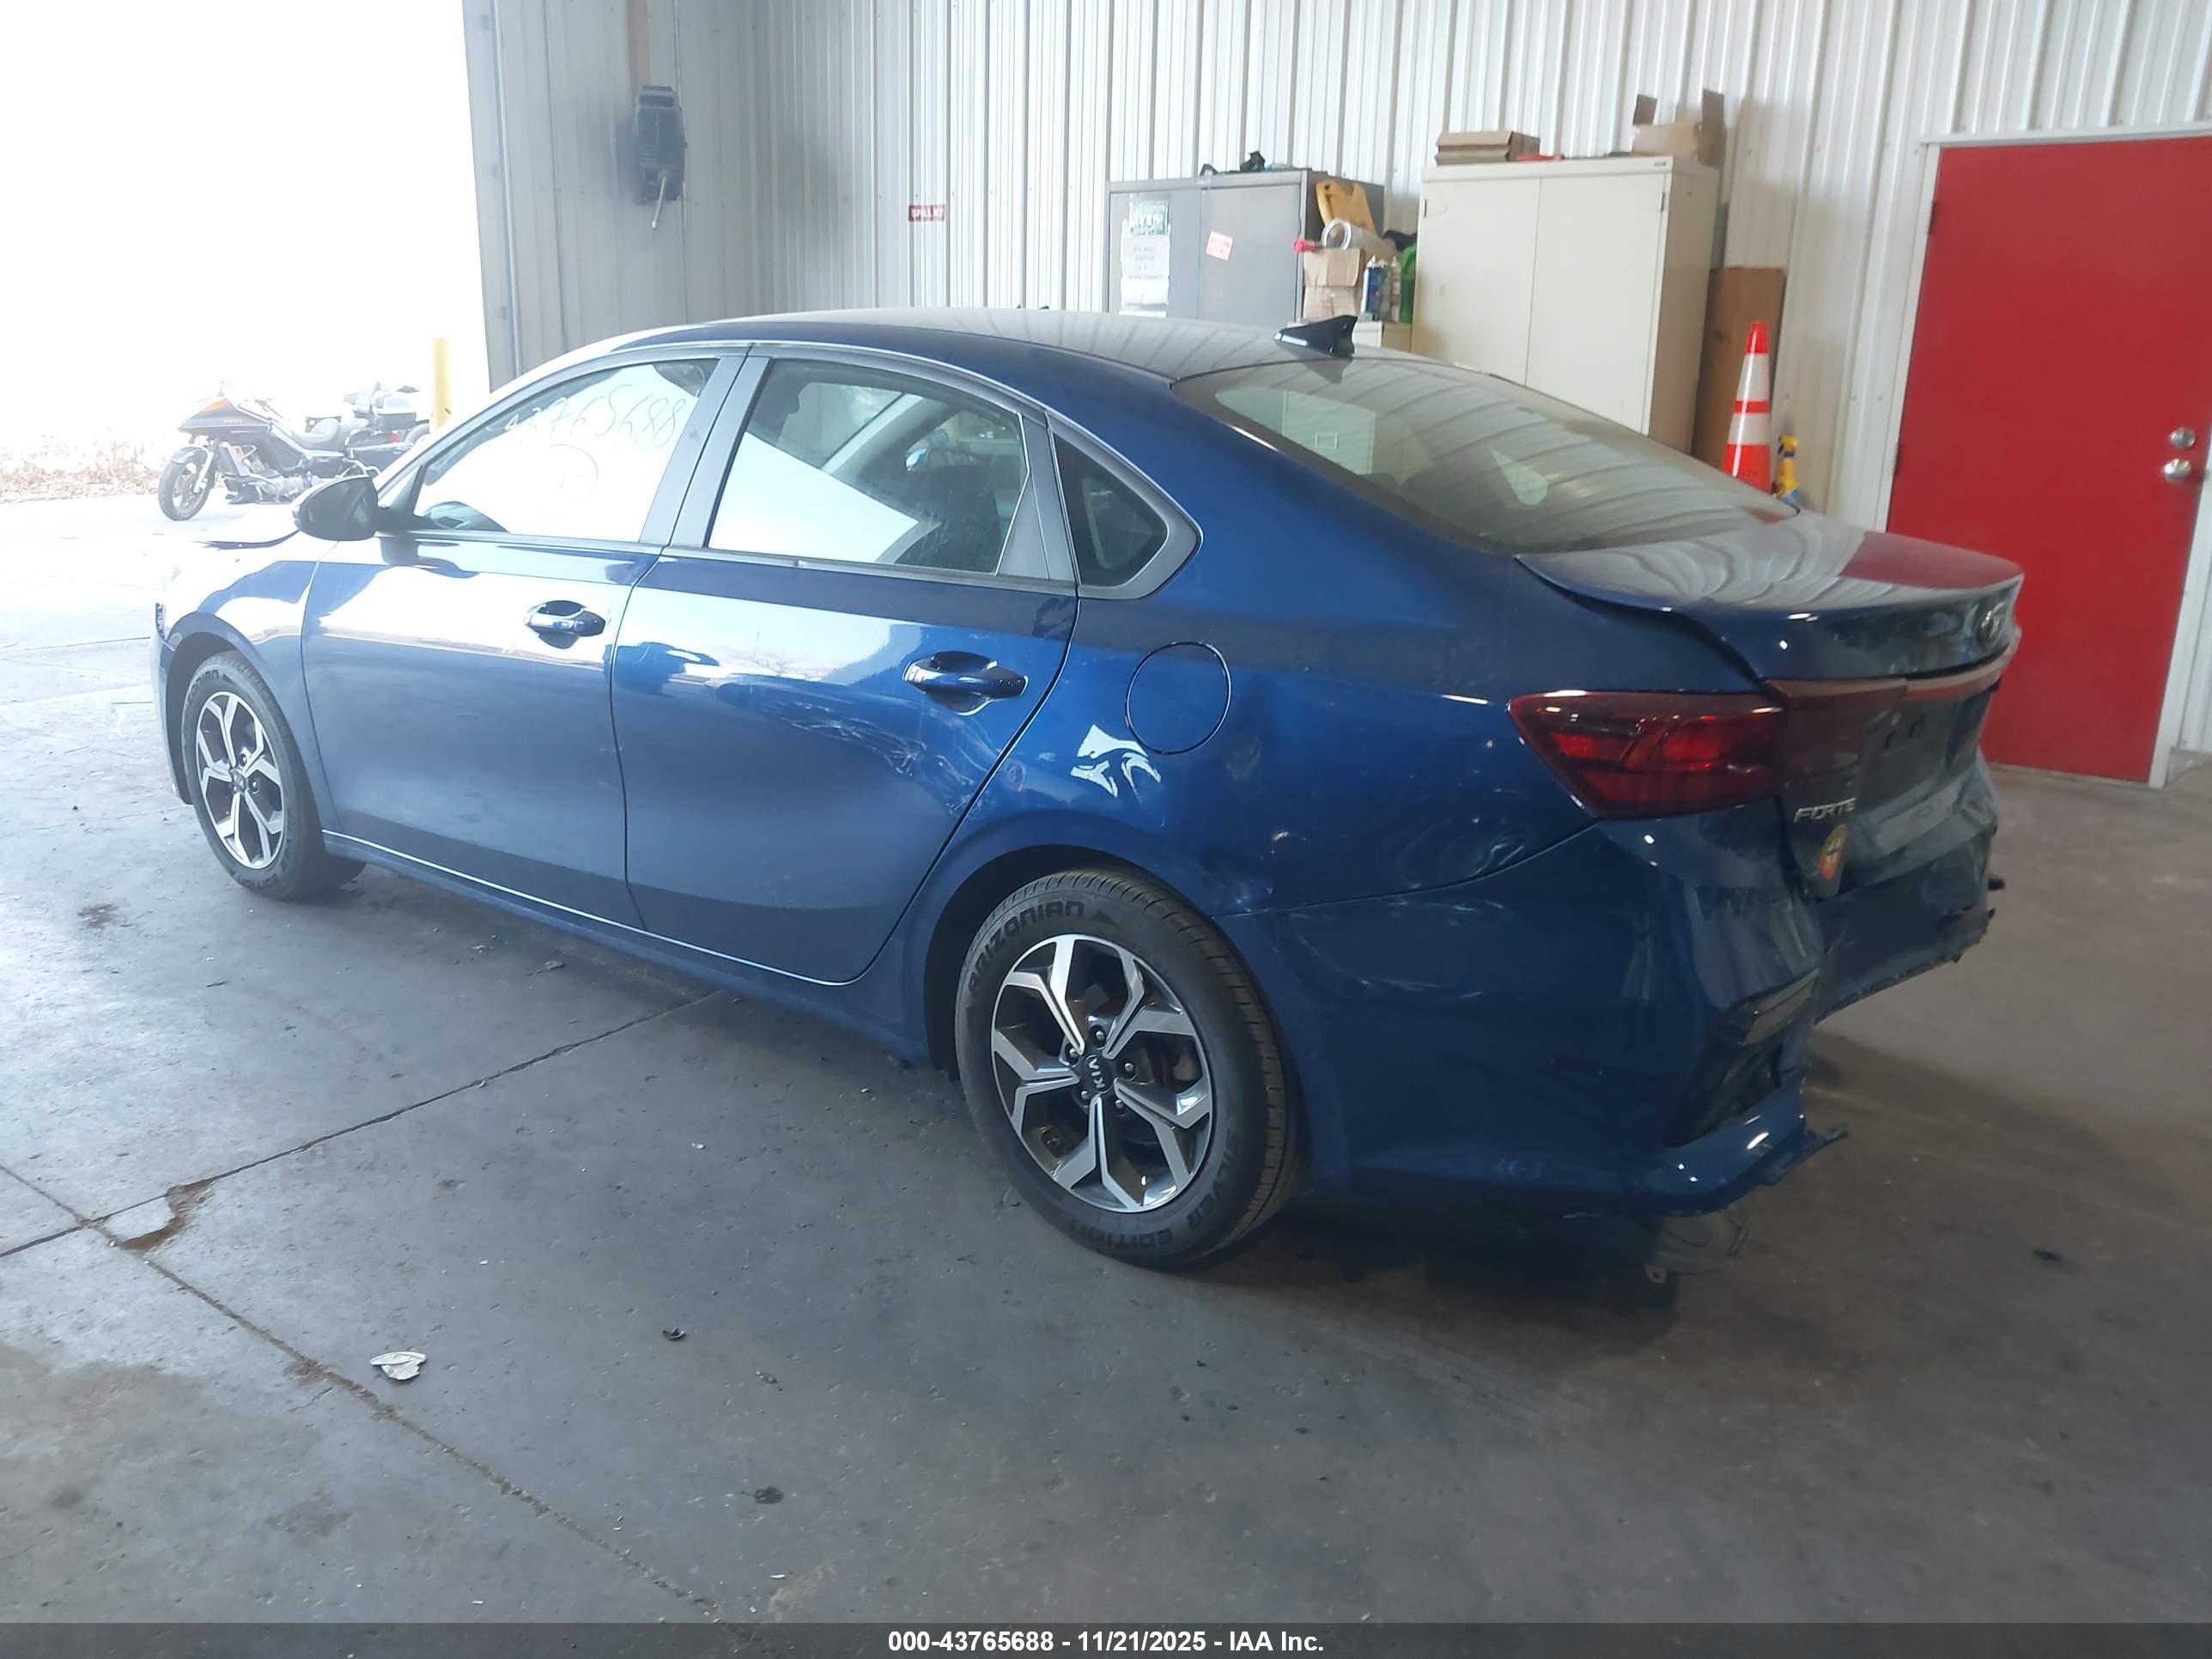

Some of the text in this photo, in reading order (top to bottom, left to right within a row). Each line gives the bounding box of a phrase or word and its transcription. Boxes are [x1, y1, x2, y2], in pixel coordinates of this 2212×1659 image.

[1793, 796, 1856, 823] FORTE
[968, 901, 1085, 991] ARIZONIAN
[1088, 1057, 1106, 1089] KIA
